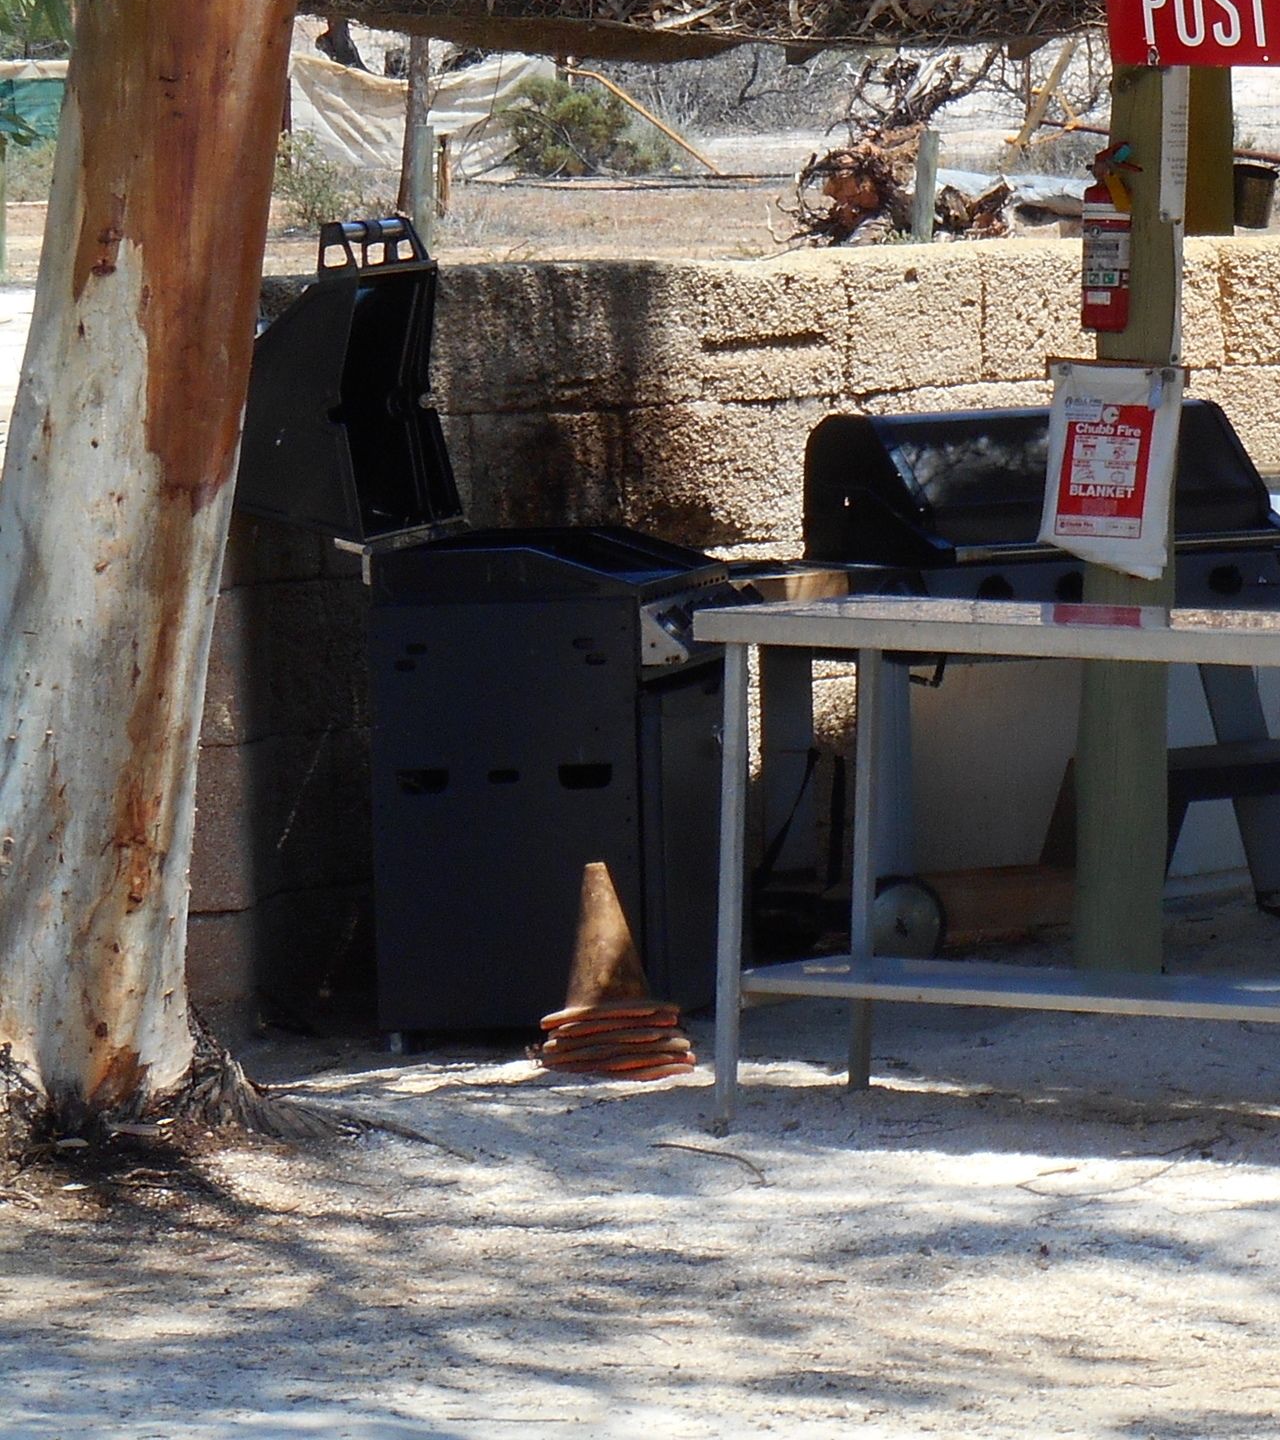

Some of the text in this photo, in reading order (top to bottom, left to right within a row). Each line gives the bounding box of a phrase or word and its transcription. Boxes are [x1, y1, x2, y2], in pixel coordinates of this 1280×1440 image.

[1075, 423, 1141, 437] Chubb Fire
[1069, 484, 1135, 498] BLANKET
